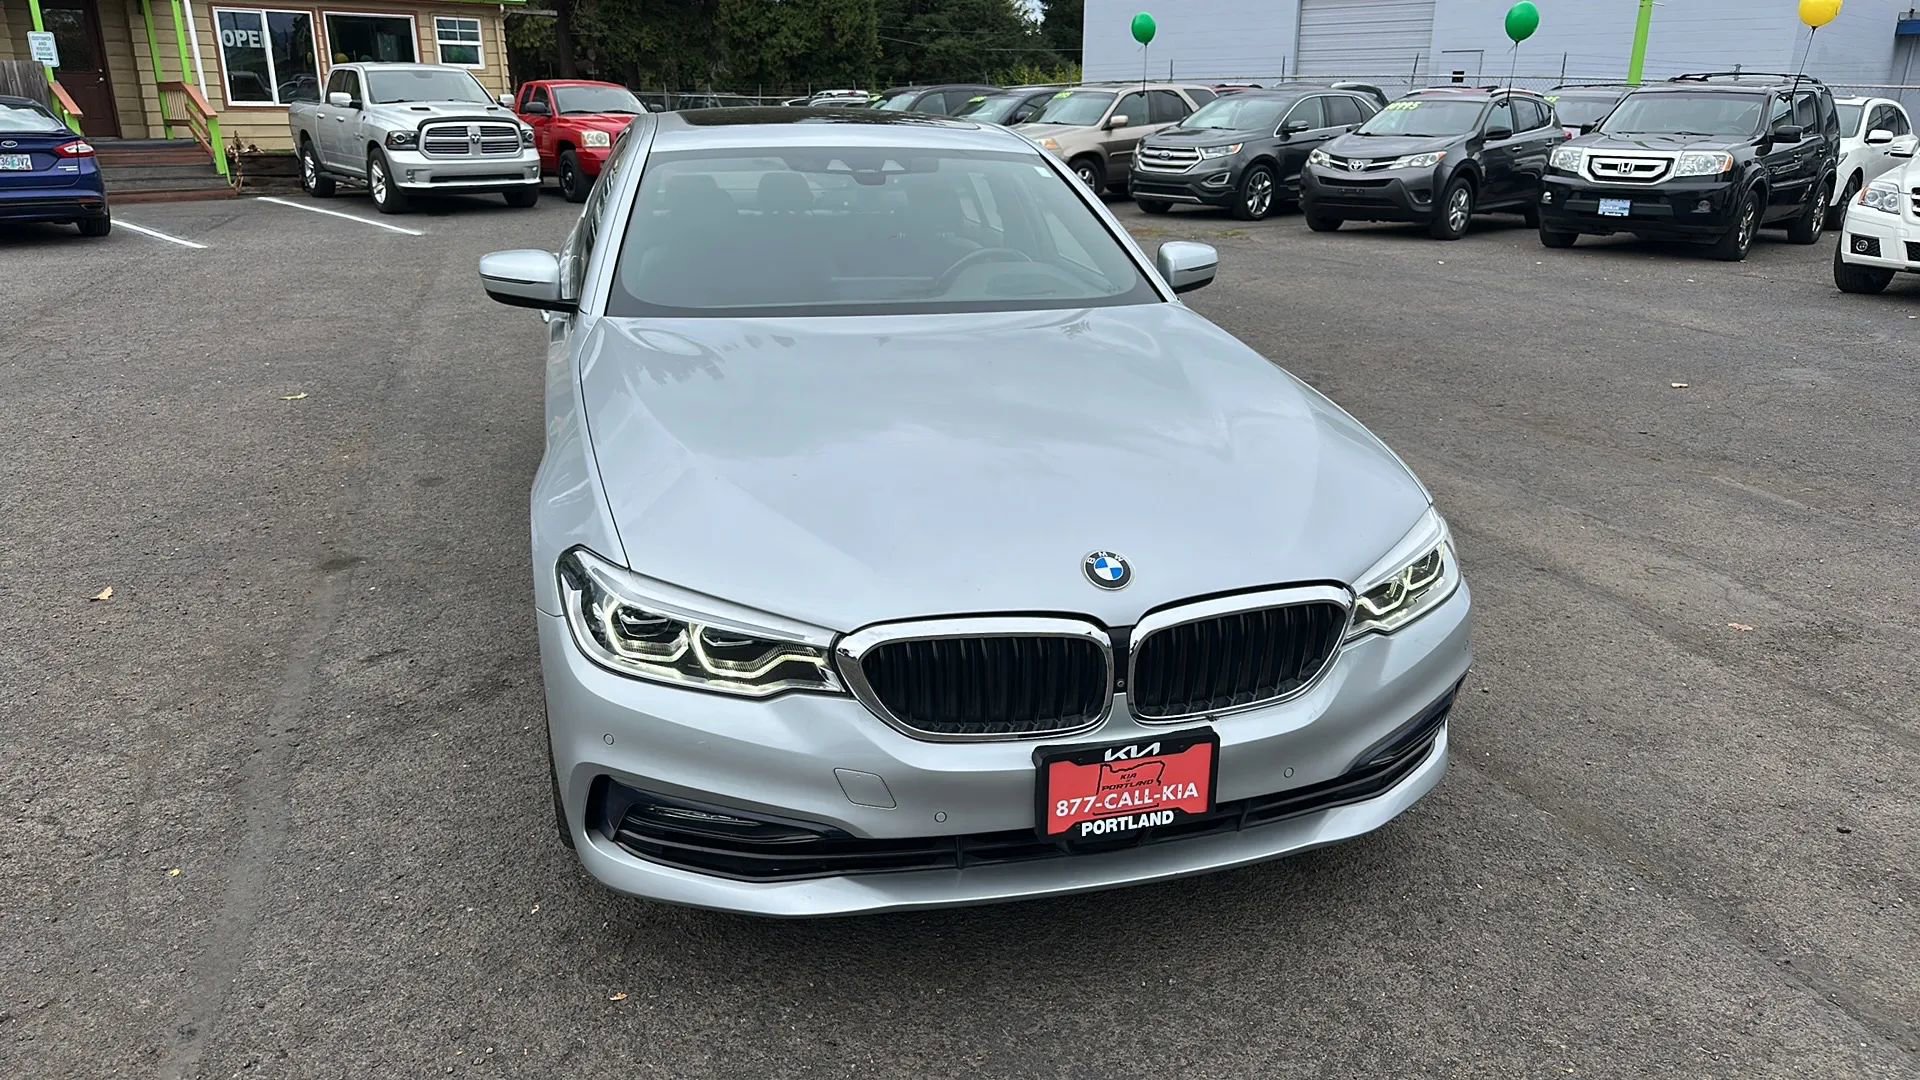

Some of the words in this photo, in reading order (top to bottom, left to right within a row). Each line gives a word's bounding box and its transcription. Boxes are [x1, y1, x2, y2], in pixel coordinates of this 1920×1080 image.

[1087, 551, 1123, 564] BMW
[1104, 742, 1161, 761] KIA
[1102, 779, 1154, 791] PORTLAND
[1056, 782, 1199, 817] 877-CALL-KIA
[1081, 810, 1175, 837] PORTLAND
